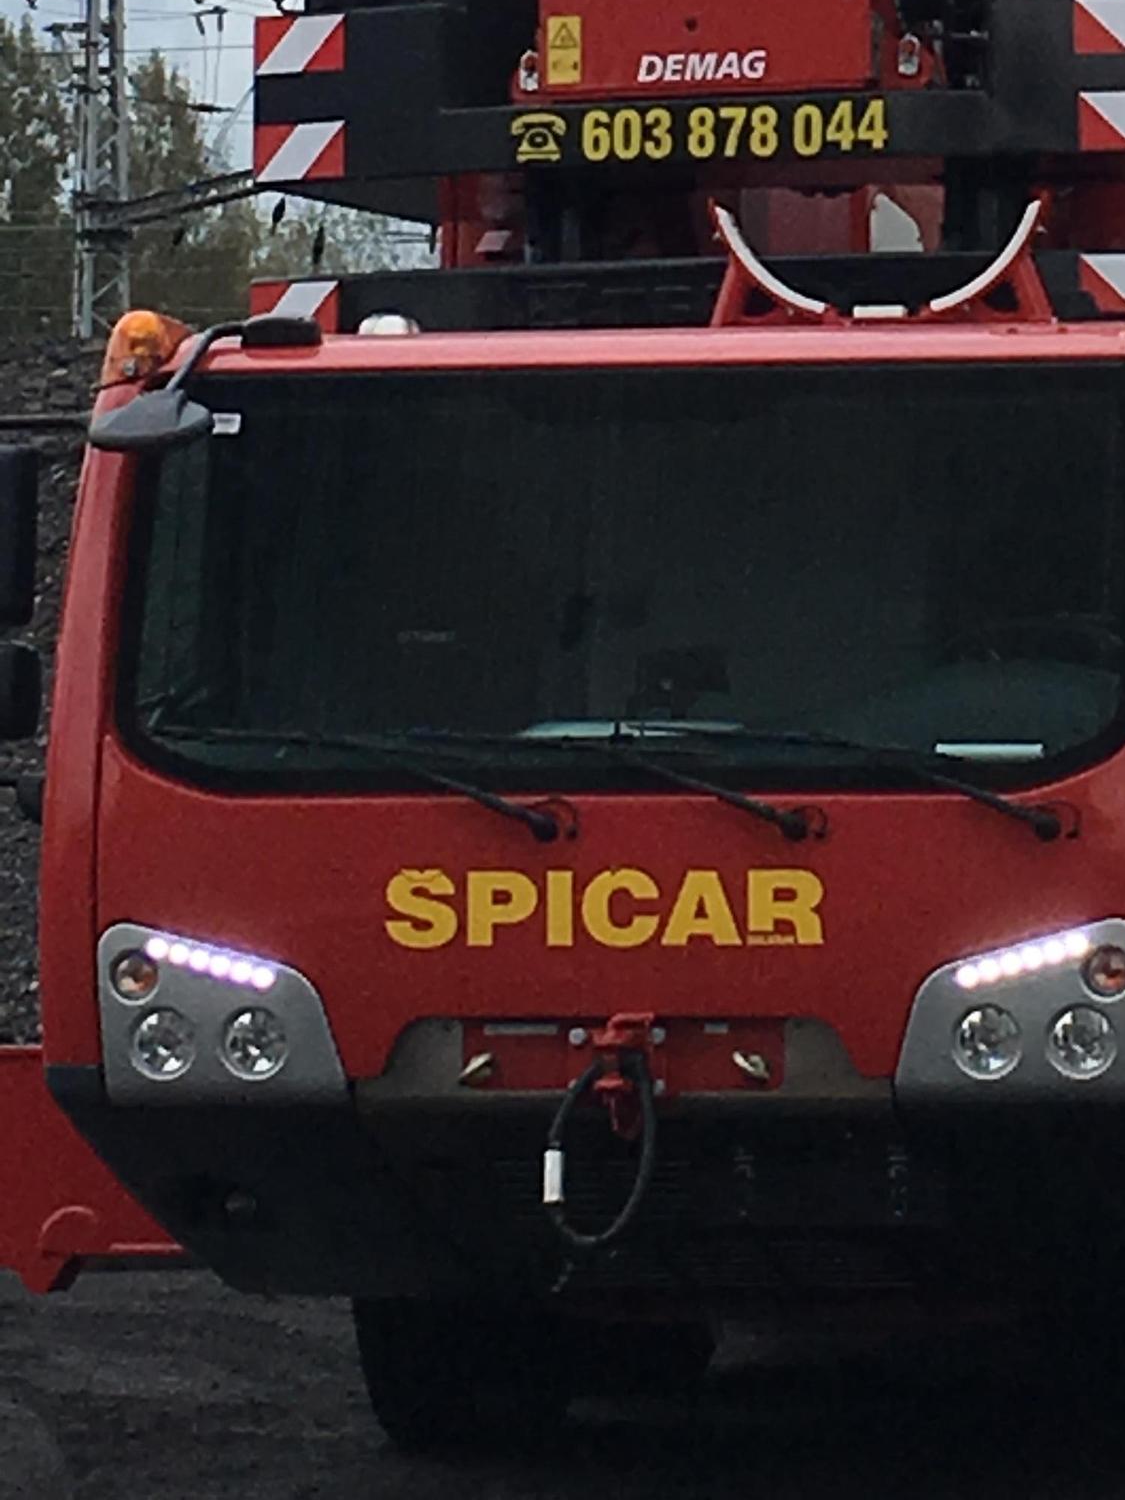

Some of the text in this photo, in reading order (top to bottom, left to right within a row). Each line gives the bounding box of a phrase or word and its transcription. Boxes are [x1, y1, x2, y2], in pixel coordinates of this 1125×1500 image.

[637, 50, 766, 83] DEMAG
[582, 99, 888, 161] 603 878 044
